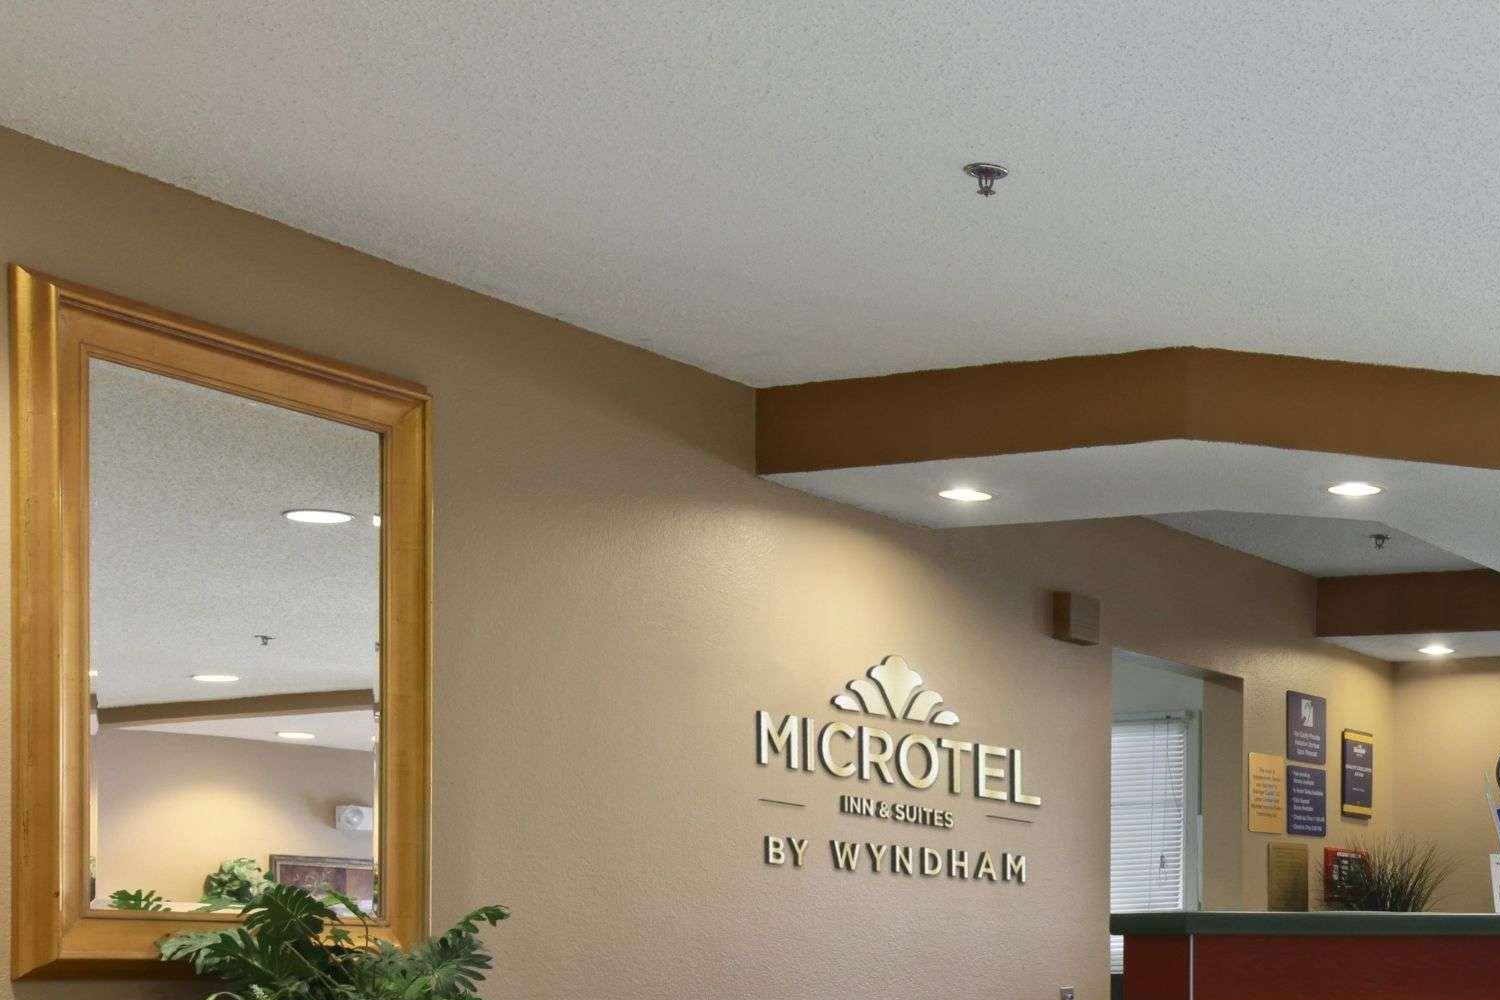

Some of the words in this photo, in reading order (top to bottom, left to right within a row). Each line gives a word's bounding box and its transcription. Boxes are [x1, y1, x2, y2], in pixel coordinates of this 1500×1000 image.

[757, 711, 1042, 806] MICROTEL
[841, 795, 875, 817] INN
[876, 801, 891, 819] &
[894, 804, 955, 828] SUITES
[765, 835, 809, 867] BY
[830, 839, 1027, 884] WYNDHAM
